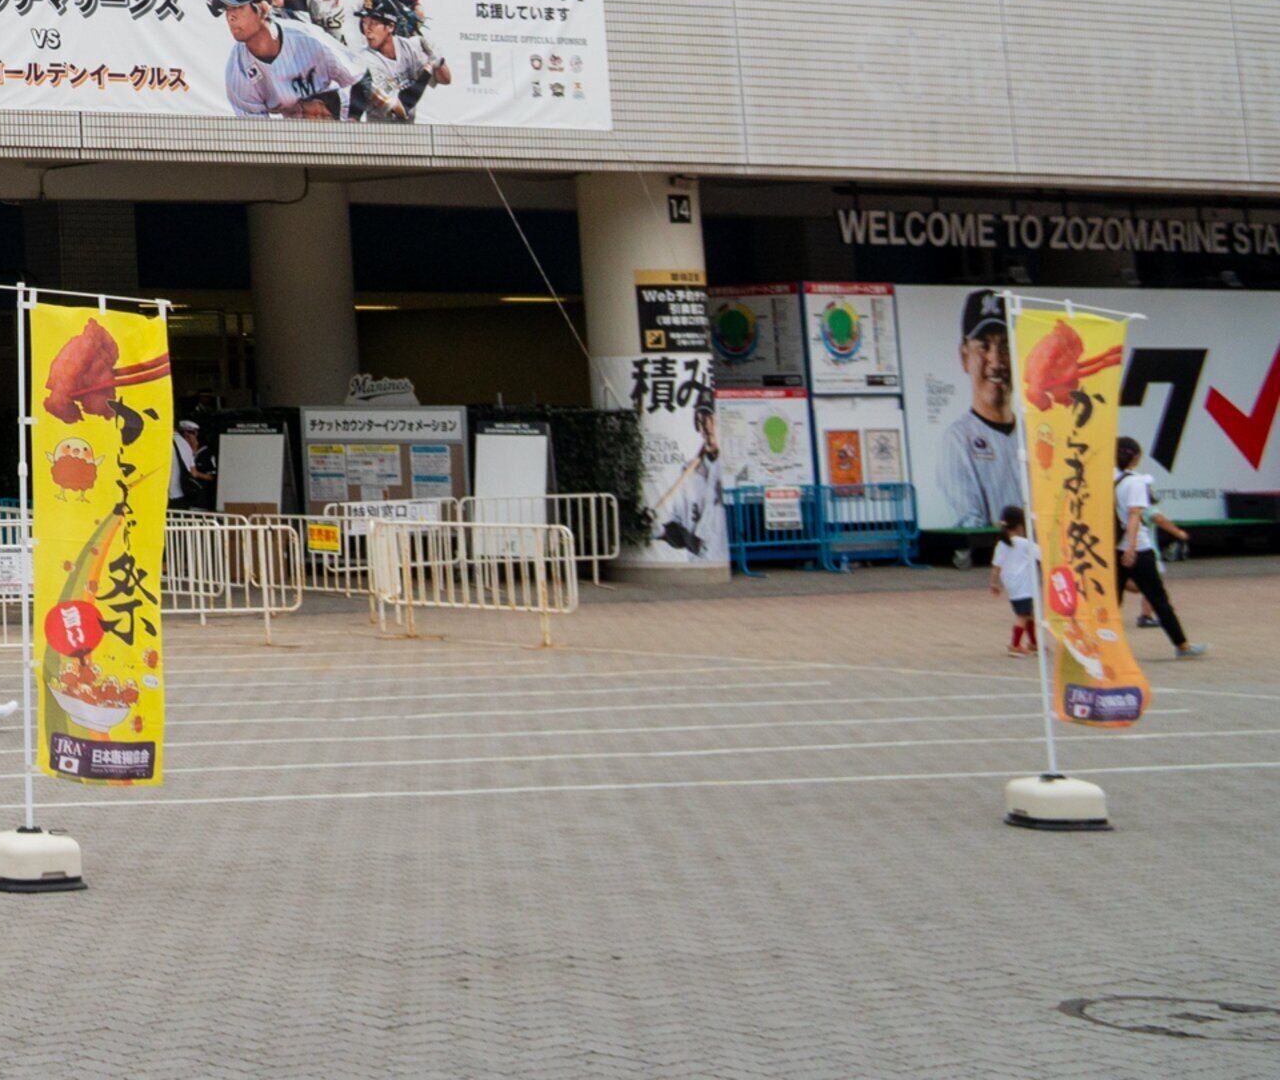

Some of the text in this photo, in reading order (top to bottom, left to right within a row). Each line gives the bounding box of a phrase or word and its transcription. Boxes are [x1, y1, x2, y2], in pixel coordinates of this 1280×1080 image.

[476, 2, 570, 22] 応援しています
[670, 199, 690, 219] 14
[839, 211, 997, 248] WELCOME
[1003, 213, 1040, 249] TO
[1049, 216, 1228, 253] ZOZOMARINE
[309, 418, 457, 433] チケットカウンターインフォメーション
[56, 738, 82, 756] JKA
